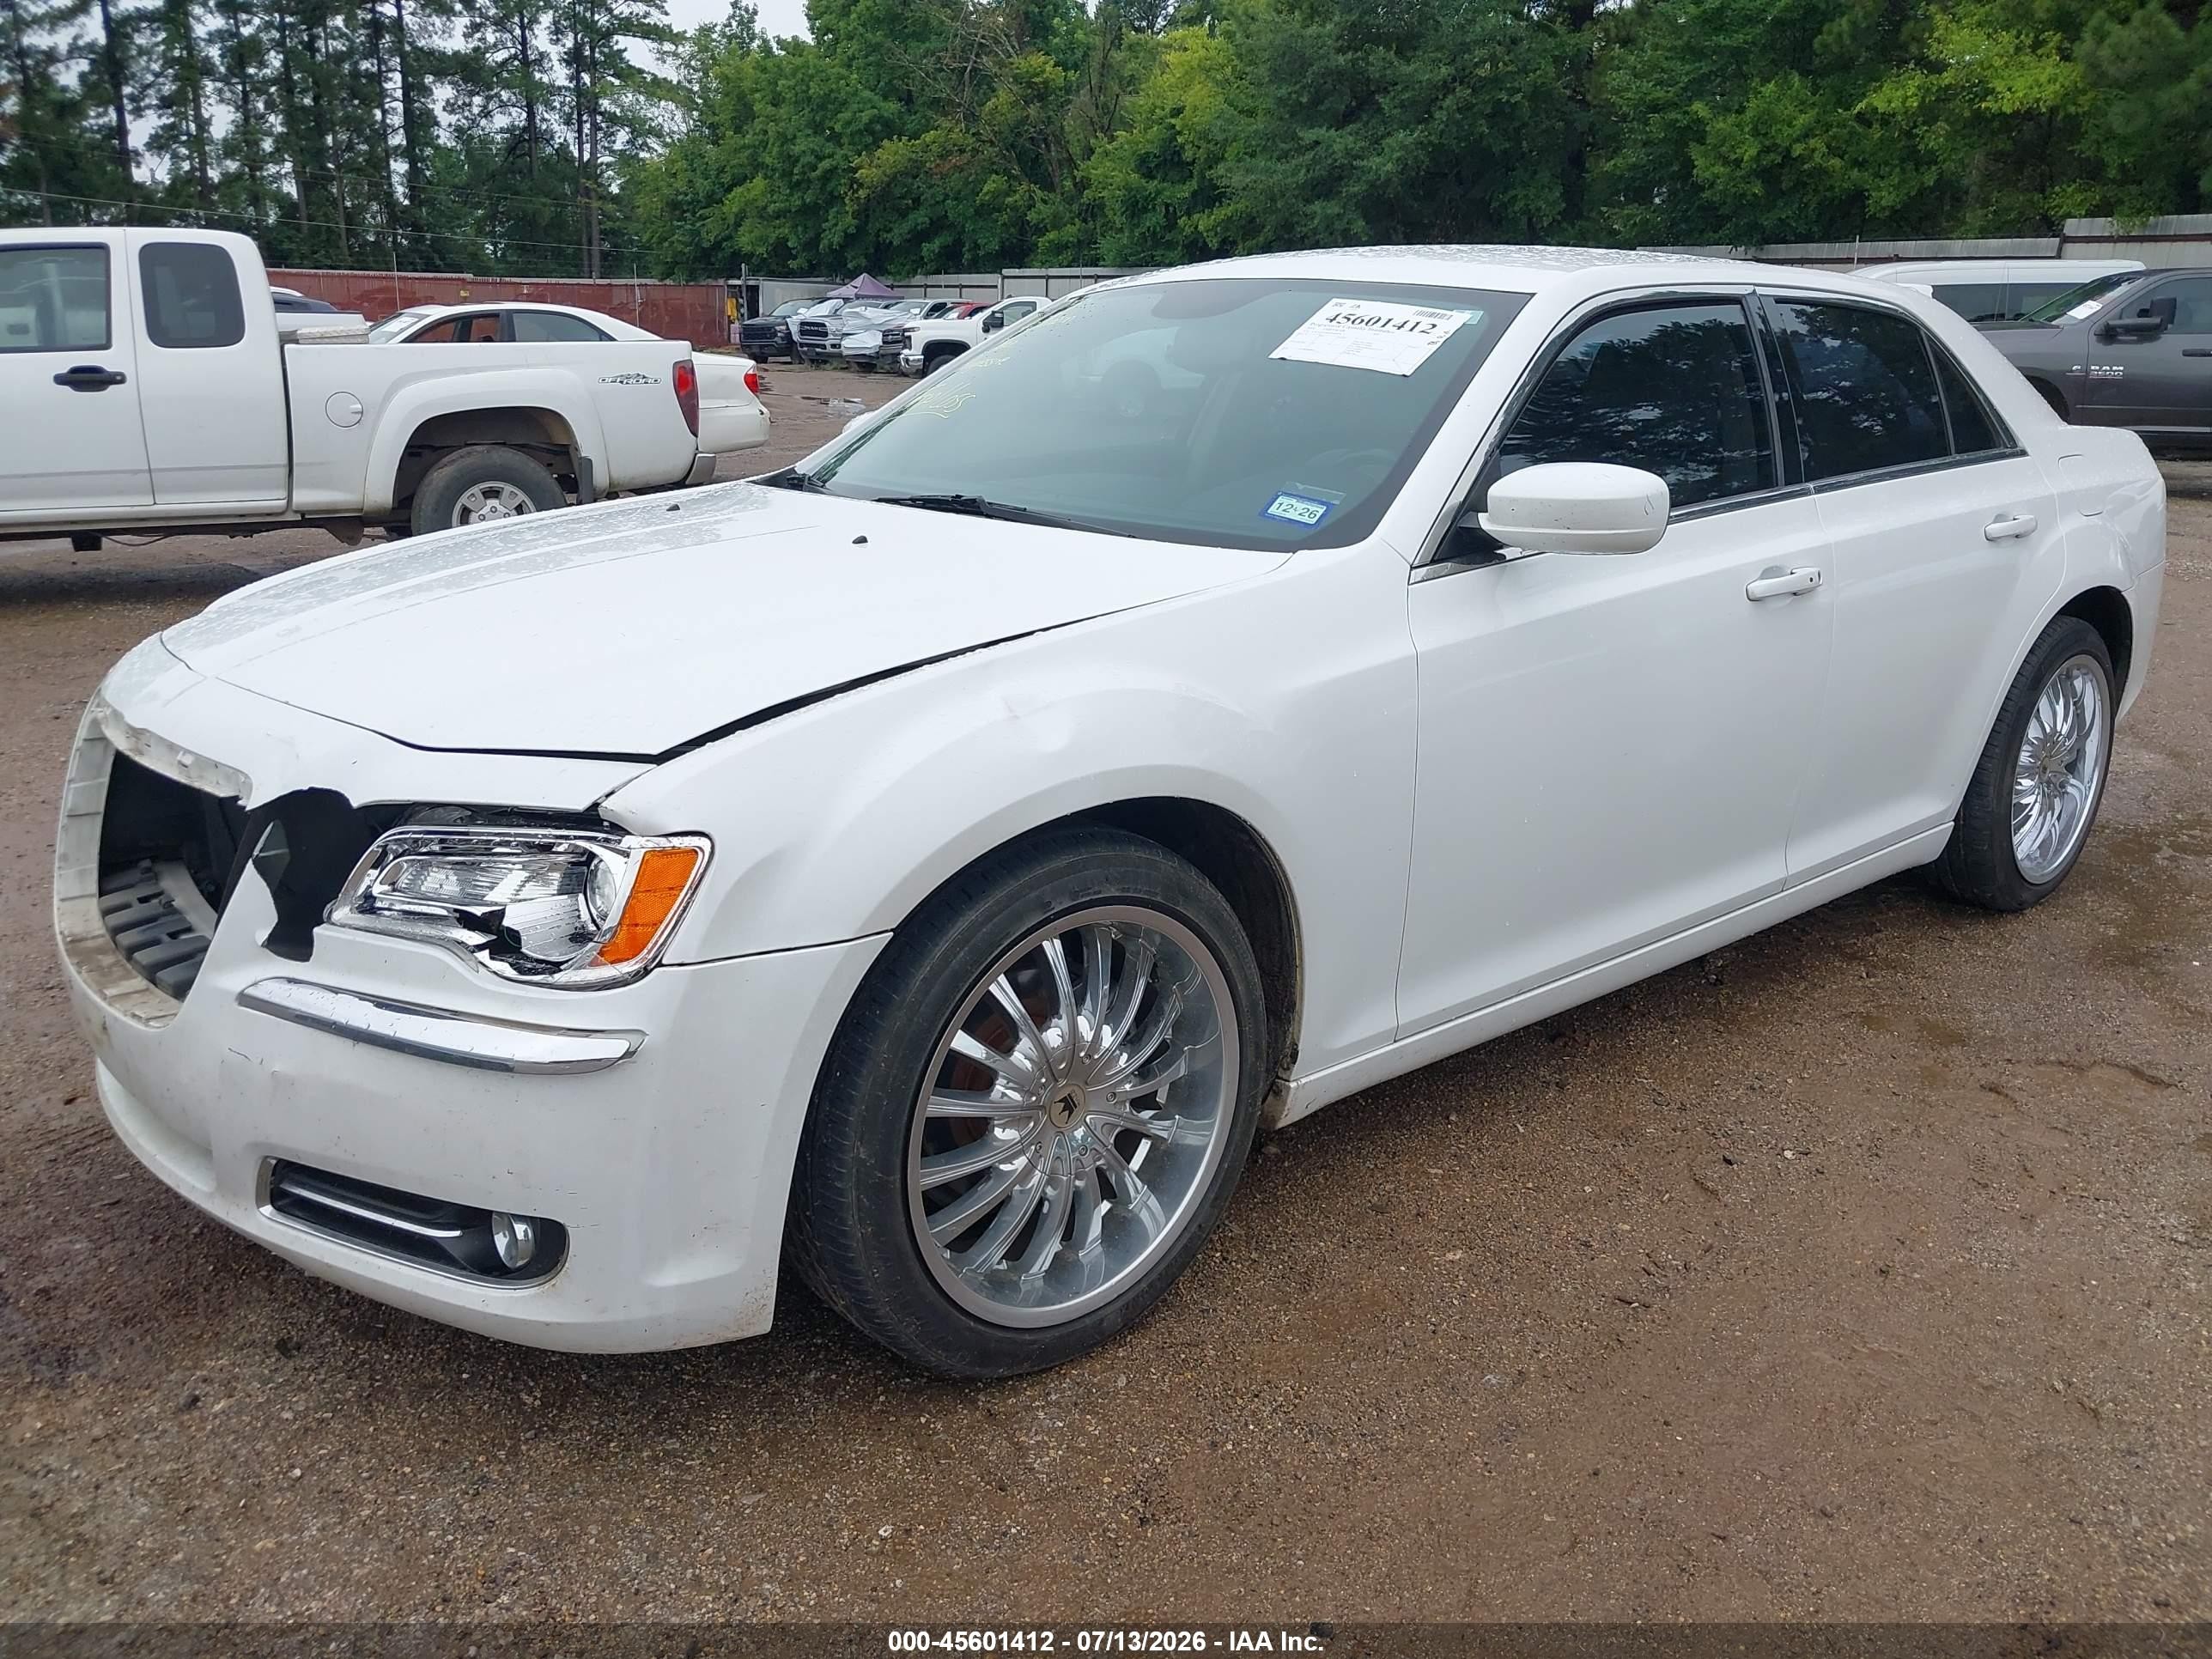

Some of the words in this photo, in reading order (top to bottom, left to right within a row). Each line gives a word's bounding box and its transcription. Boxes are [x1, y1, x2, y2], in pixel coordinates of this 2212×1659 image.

[1325, 312, 1438, 335] 45601412
[1275, 501, 1294, 514] 12
[1297, 507, 1320, 520] 26
